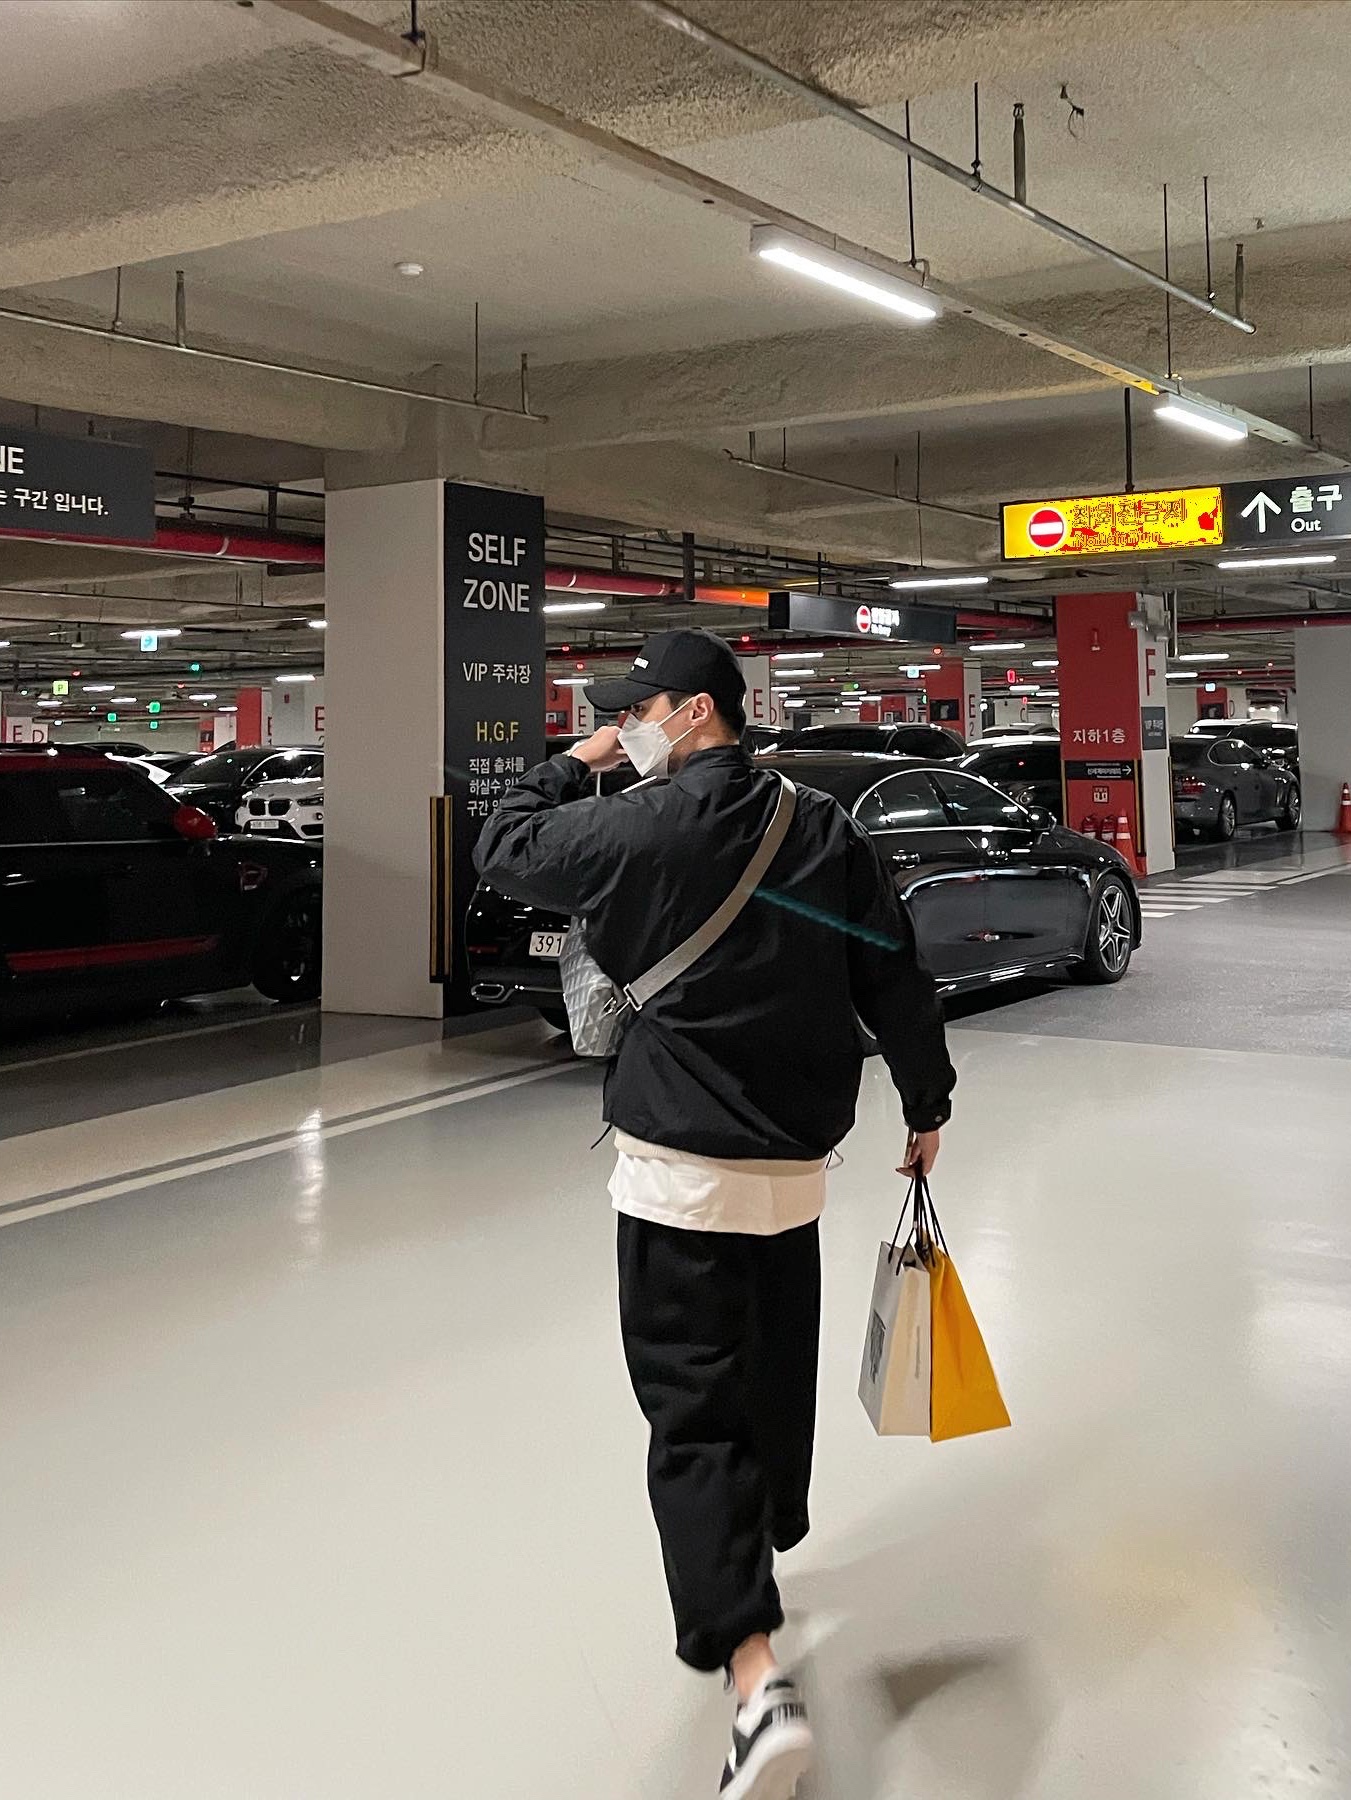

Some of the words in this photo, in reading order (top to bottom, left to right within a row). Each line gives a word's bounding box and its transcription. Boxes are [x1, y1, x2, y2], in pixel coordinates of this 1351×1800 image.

[13, 488, 48, 510] 구간
[54, 493, 109, 516] 입니다.
[1290, 485, 1343, 513] 출구
[1291, 517, 1322, 533] Out
[468, 532, 526, 567] SELF
[463, 578, 530, 613] ZONE
[463, 662, 487, 682] VIP
[492, 663, 531, 684] 주차장
[1145, 648, 1156, 697] F
[753, 688, 763, 718] E
[968, 693, 976, 719] E
[578, 705, 587, 727] E
[13, 725, 23, 742] E
[32, 729, 44, 743] D
[1073, 728, 1126, 744] 지하1층
[469, 758, 490, 775] 직접
[494, 756, 526, 774] 출차를
[469, 778, 501, 796] 하실수
[467, 799, 489, 817] 구간
[535, 935, 563, 954] 391
